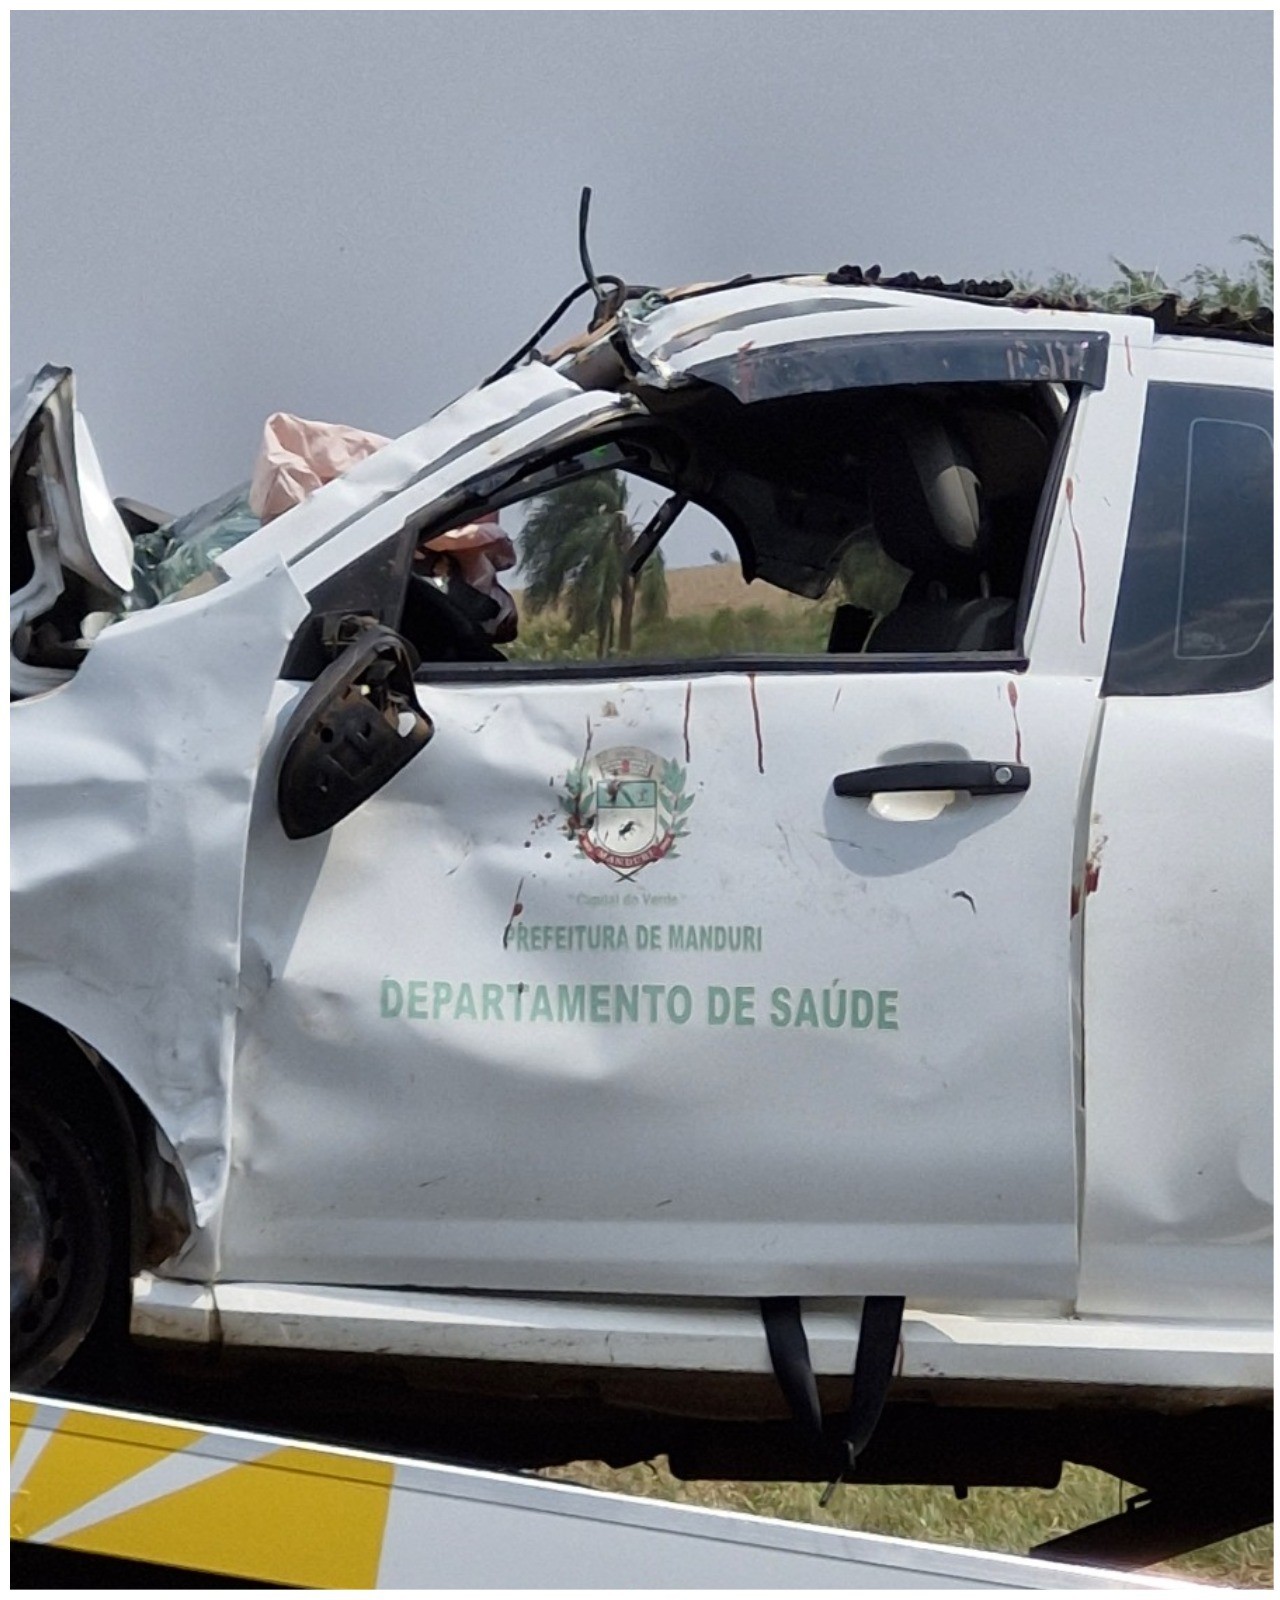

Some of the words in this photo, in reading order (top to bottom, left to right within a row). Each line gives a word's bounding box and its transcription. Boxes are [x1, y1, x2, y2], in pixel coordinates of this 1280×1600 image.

[598, 848, 655, 867] MANDURI
[505, 924, 628, 951] PREFEITURA
[635, 924, 662, 950] DE
[668, 924, 763, 952] MANDURI
[379, 978, 693, 1025] DEPARTAMENTO
[707, 985, 756, 1026] DE
[769, 977, 899, 1030] SAÚDE
